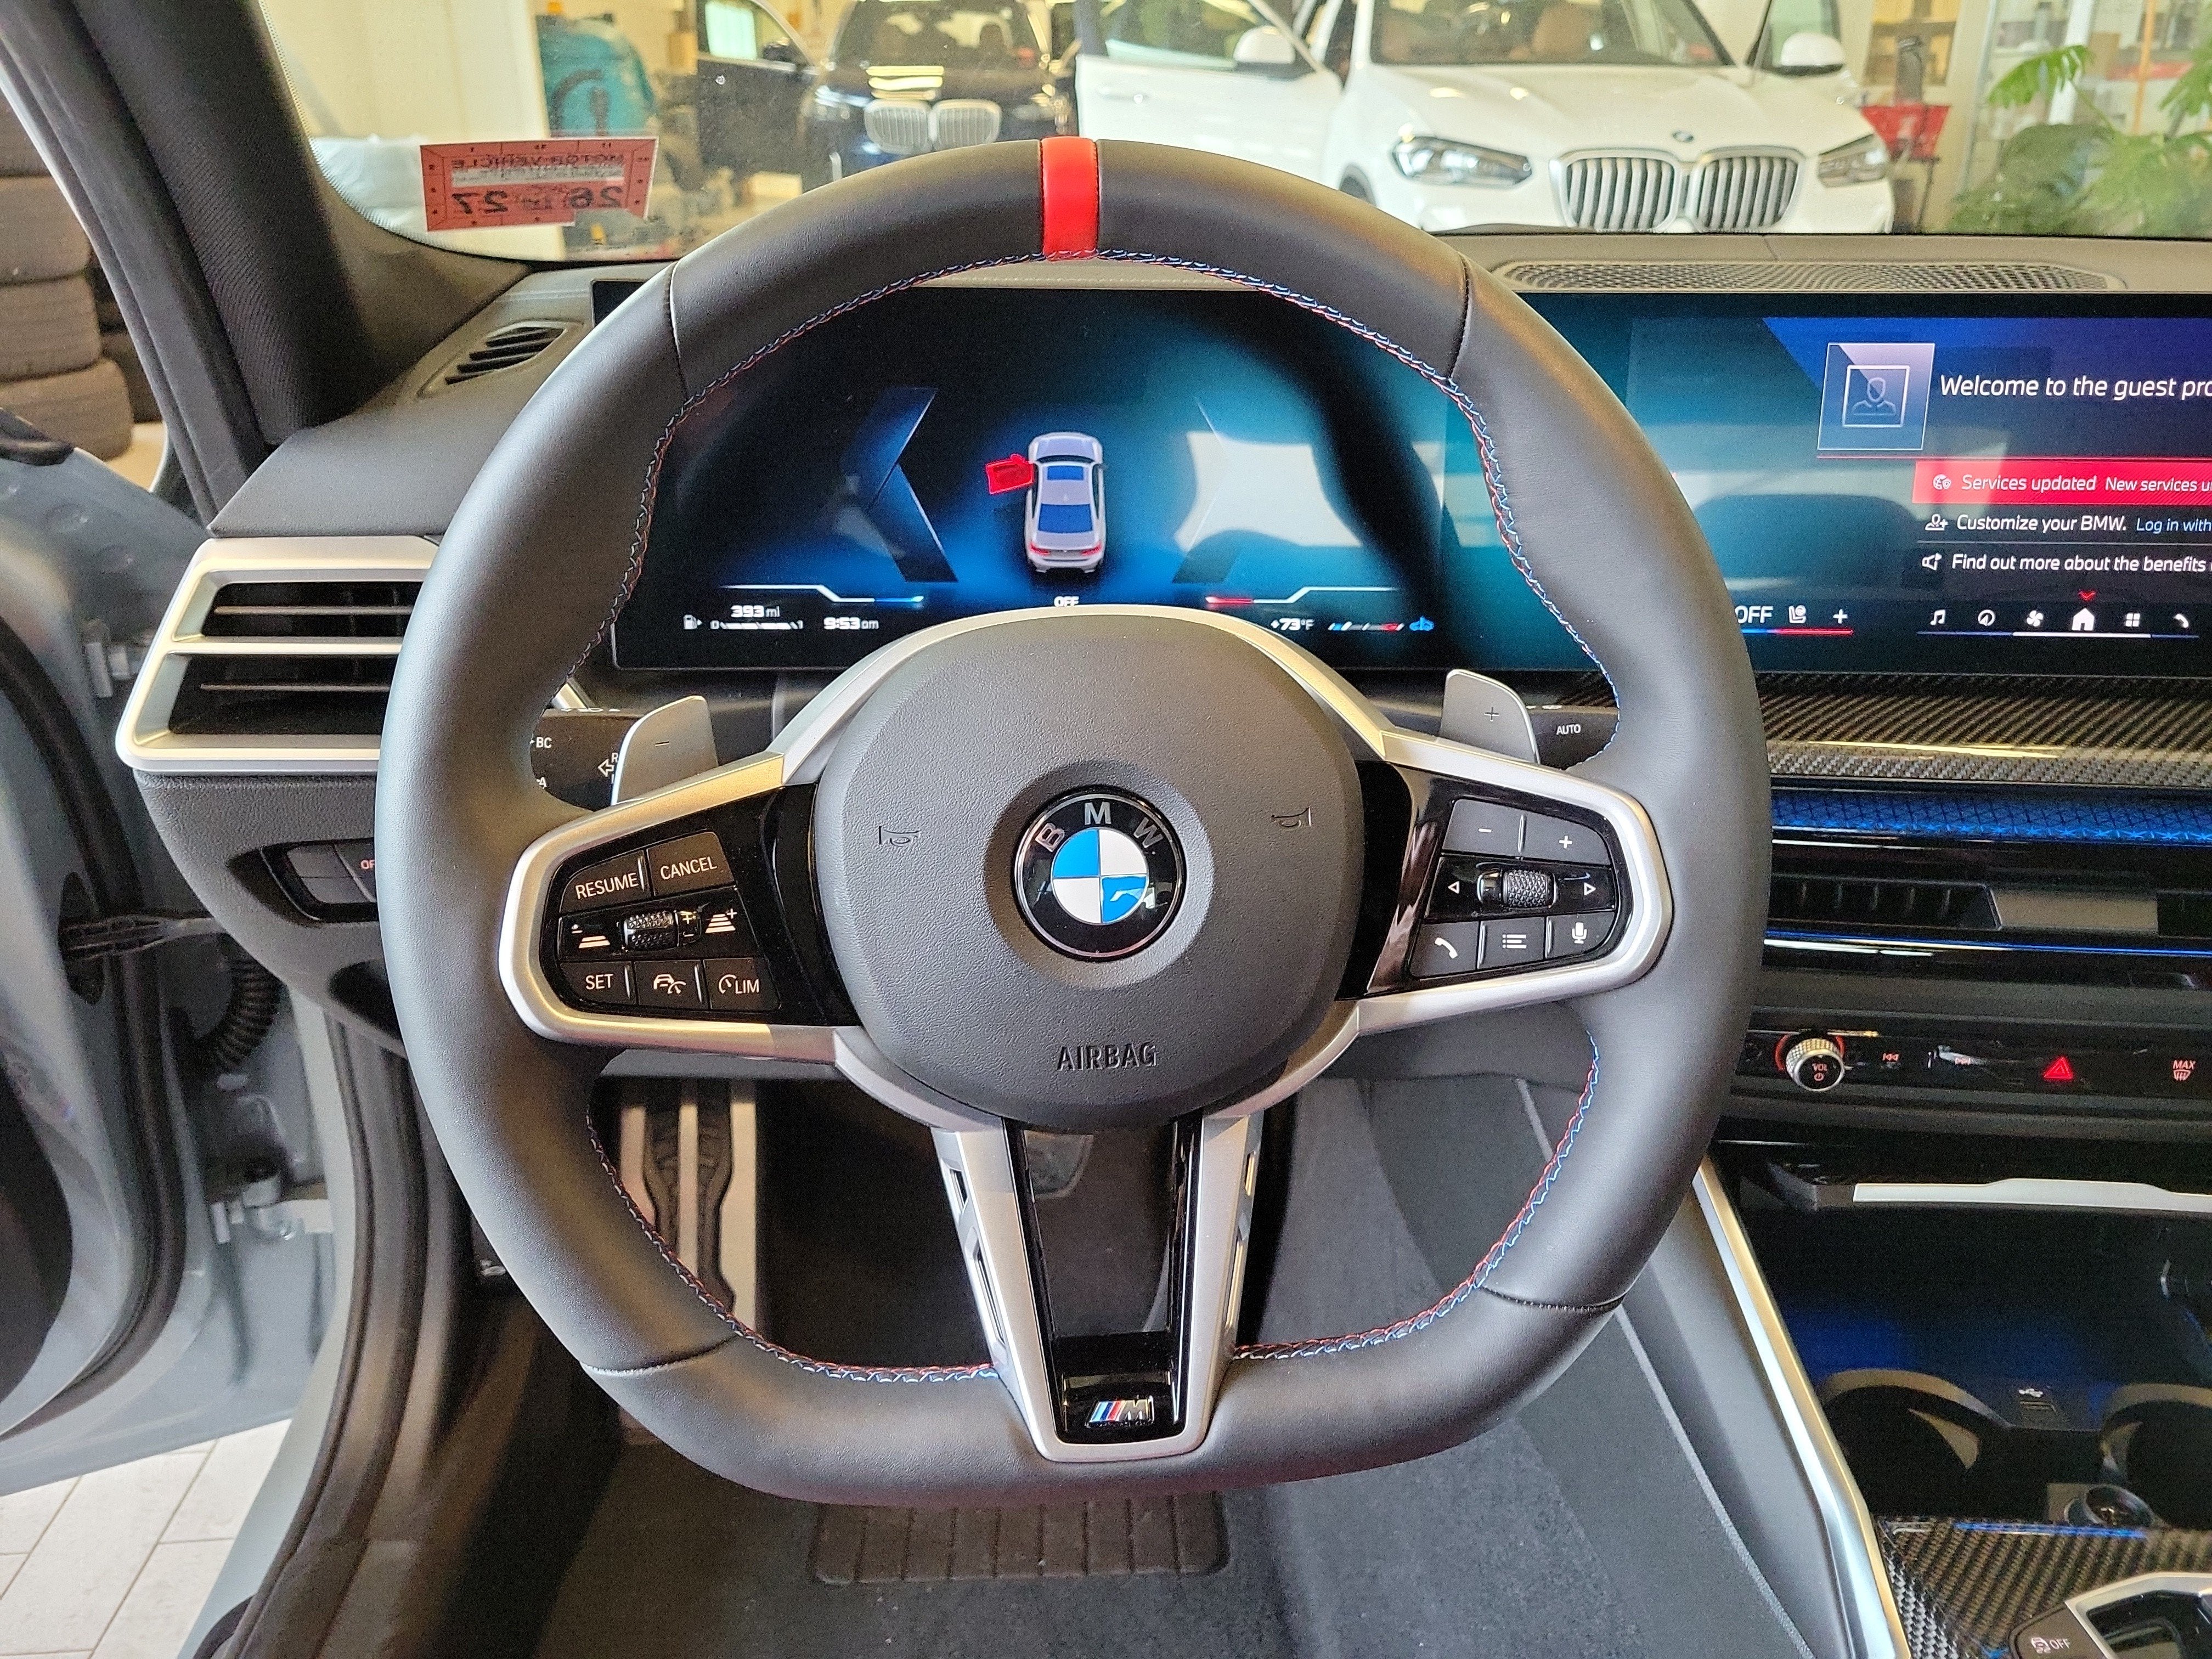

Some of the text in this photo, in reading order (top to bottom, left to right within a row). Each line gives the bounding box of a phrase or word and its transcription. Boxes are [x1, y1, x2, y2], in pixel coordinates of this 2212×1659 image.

[1940, 374, 2039, 396] Welcome
[2045, 375, 2066, 396] to
[2073, 375, 2107, 396] the
[2113, 377, 2176, 401] guest
[1962, 474, 2027, 490] Services
[2031, 476, 2096, 493] updated
[2105, 477, 2137, 491] New
[2140, 478, 2197, 492] services
[1957, 514, 2038, 531] Customize
[2042, 518, 2078, 534] your
[2081, 515, 2127, 531] BMW.
[2136, 518, 2163, 534] Log
[2166, 518, 2179, 532] in
[1952, 552, 1986, 569] Find
[1991, 555, 2016, 570] out
[2019, 558, 2060, 571] more
[2064, 555, 2111, 571] about
[2114, 555, 2140, 571] the
[2143, 556, 2207, 572] benefits
[1054, 596, 1079, 607] OFF
[730, 605, 765, 618] 393
[1735, 605, 1774, 623] OFF
[823, 617, 861, 630] 9:53
[1556, 724, 1582, 736] AUTO
[536, 737, 552, 749] BC
[1035, 802, 1164, 853] BMW
[660, 856, 718, 880] CANCEL
[575, 872, 639, 900] RESUME
[585, 973, 614, 990] SET
[735, 979, 760, 994] LIM
[1057, 1042, 1157, 1071] AIRBAG
[2172, 1059, 2196, 1070] MAX
[2049, 1638, 2070, 1650] OFF
